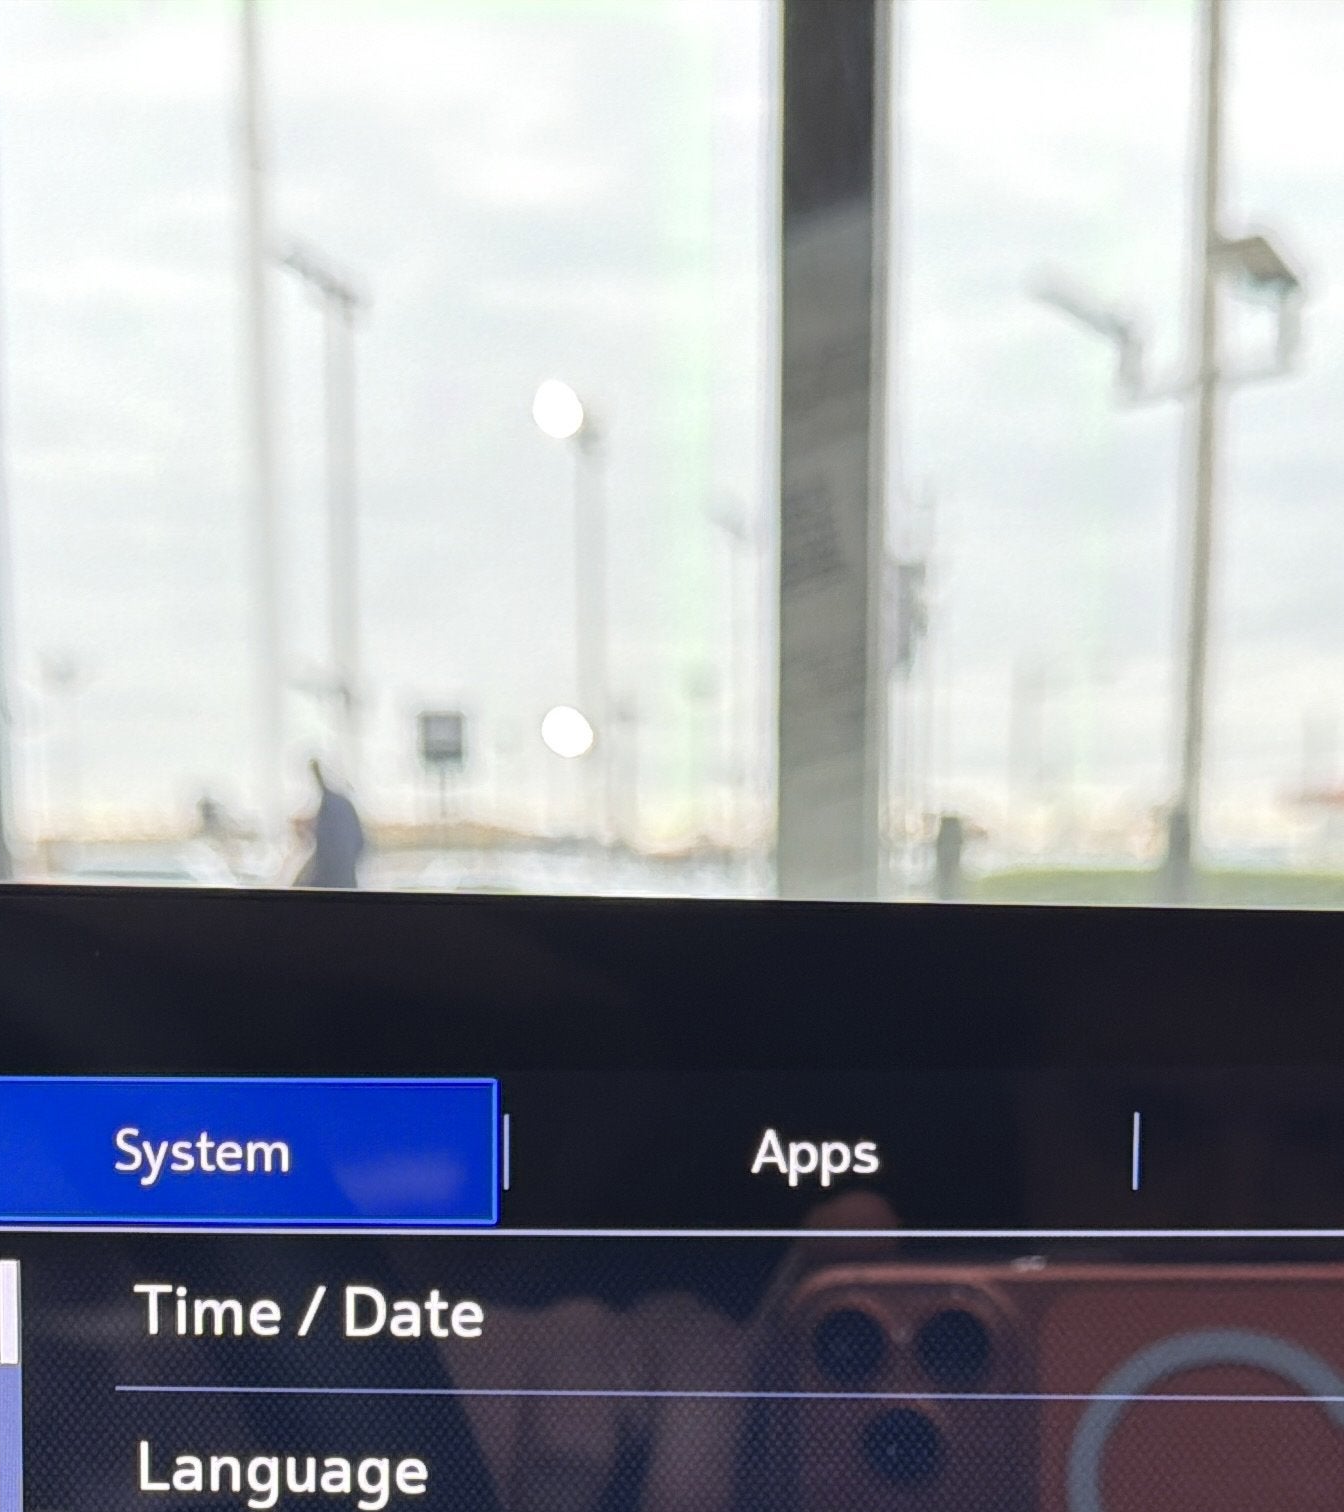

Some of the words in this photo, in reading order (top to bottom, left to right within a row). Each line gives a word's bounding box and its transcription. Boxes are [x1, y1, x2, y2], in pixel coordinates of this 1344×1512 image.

[114, 1127, 291, 1187] System
[751, 1128, 881, 1188] Apps
[133, 1284, 283, 1338] Time
[297, 1285, 328, 1339] /
[346, 1285, 486, 1340] Date
[139, 1440, 430, 1512] Language
